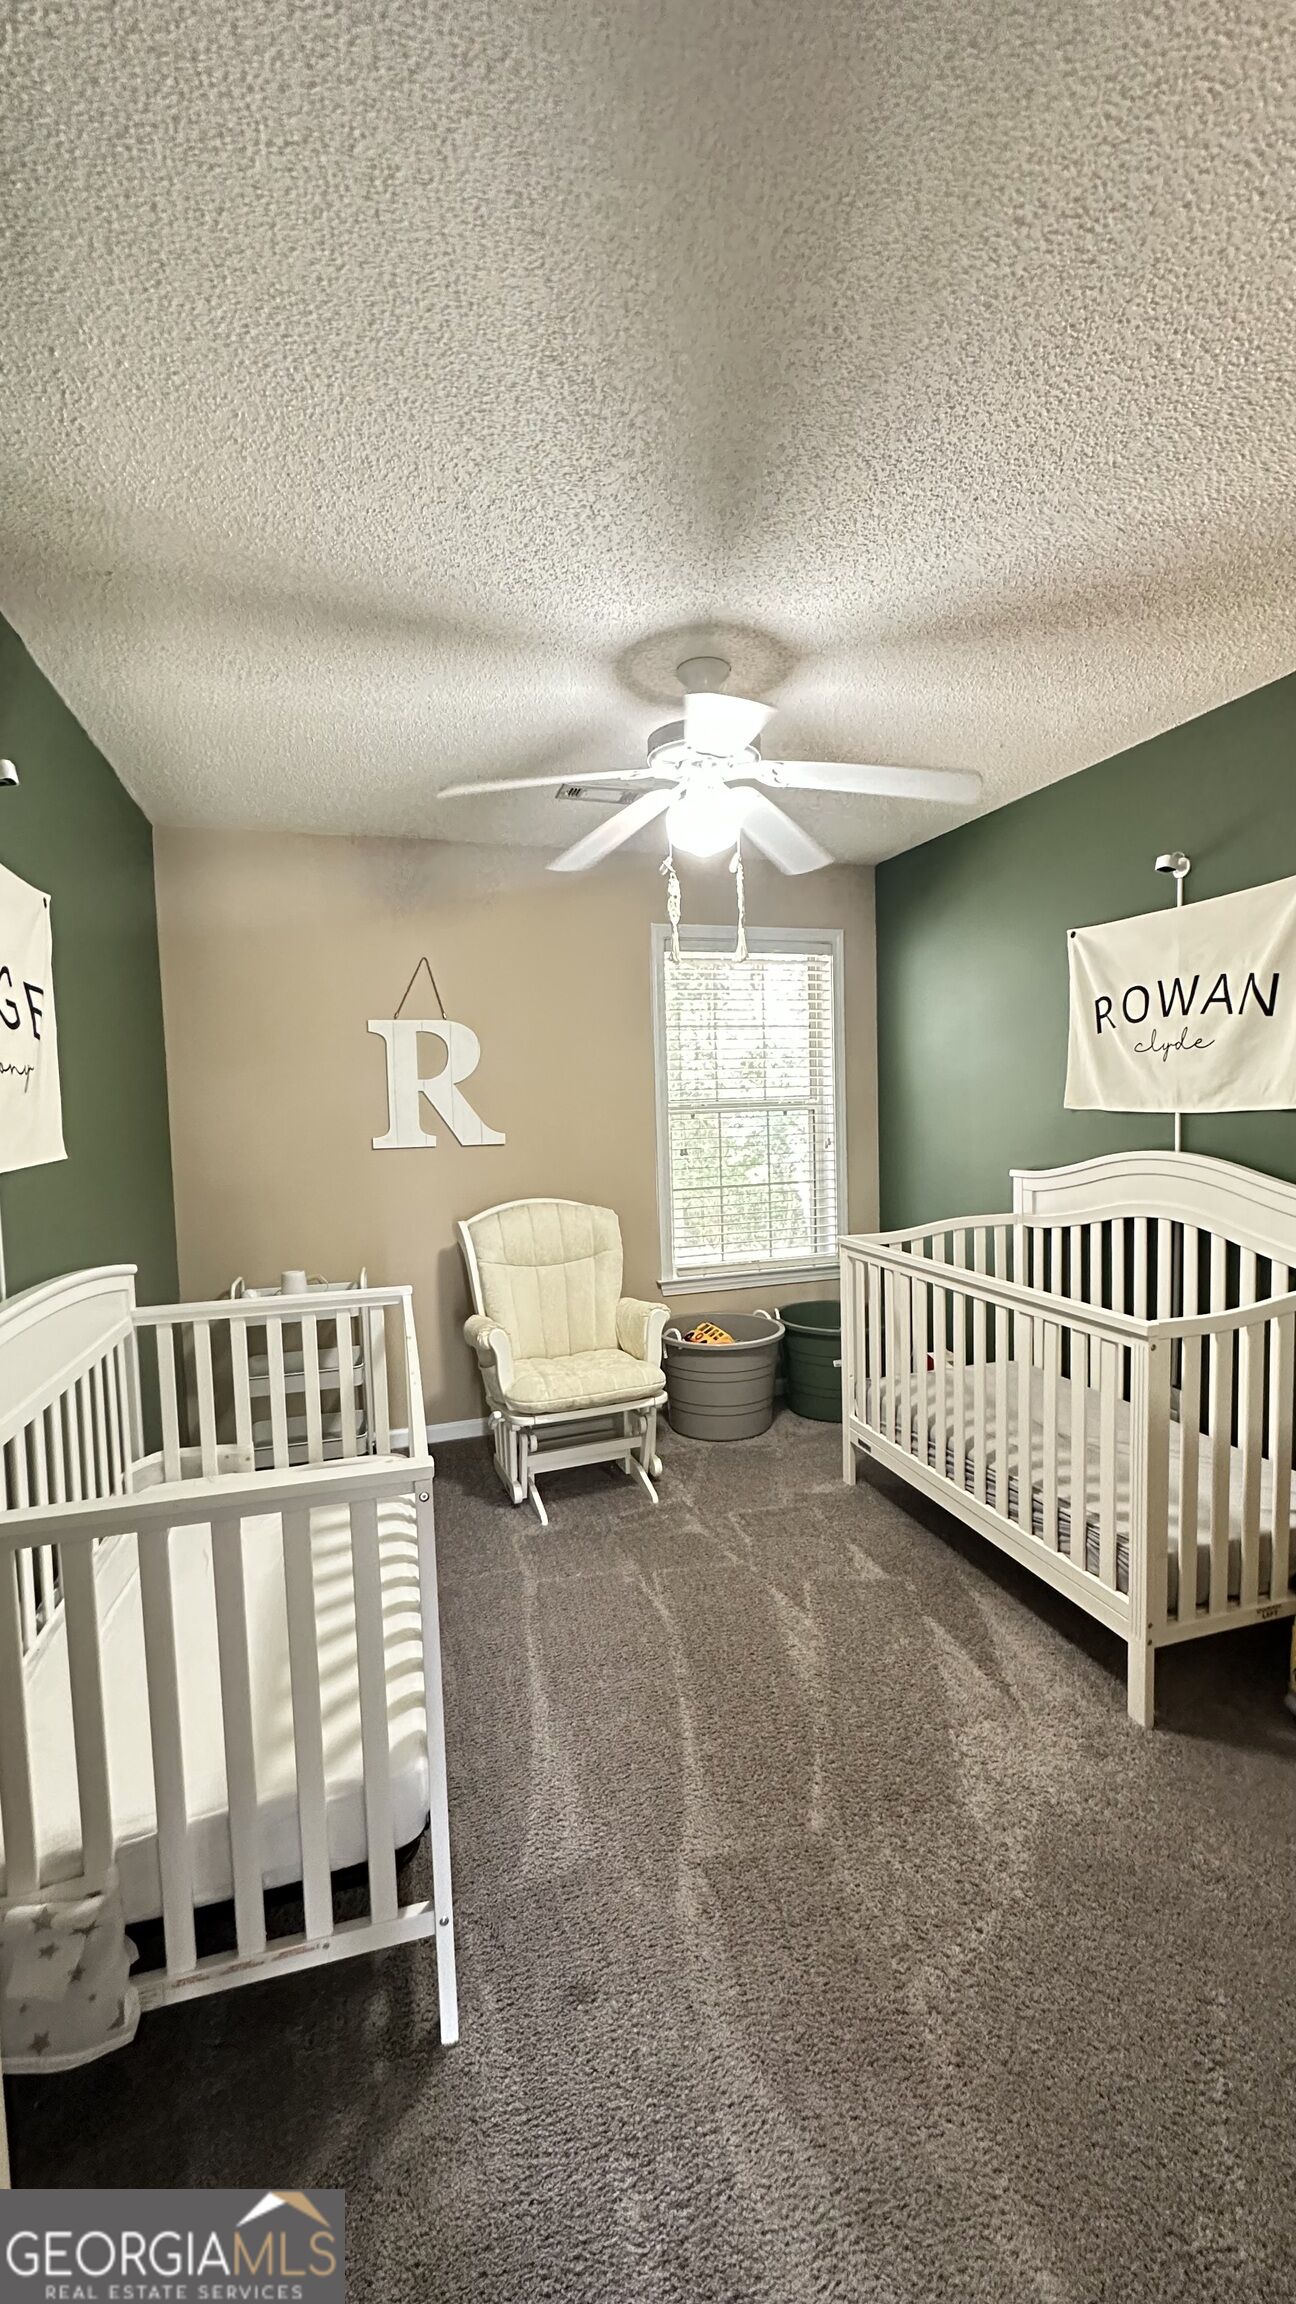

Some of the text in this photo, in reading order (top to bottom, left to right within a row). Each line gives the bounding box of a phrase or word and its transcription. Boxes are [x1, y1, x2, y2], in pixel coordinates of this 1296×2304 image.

[1094, 972, 1280, 1034] ROWAN
[1134, 1026, 1216, 1062] clyde
[367, 1019, 506, 1150] R
